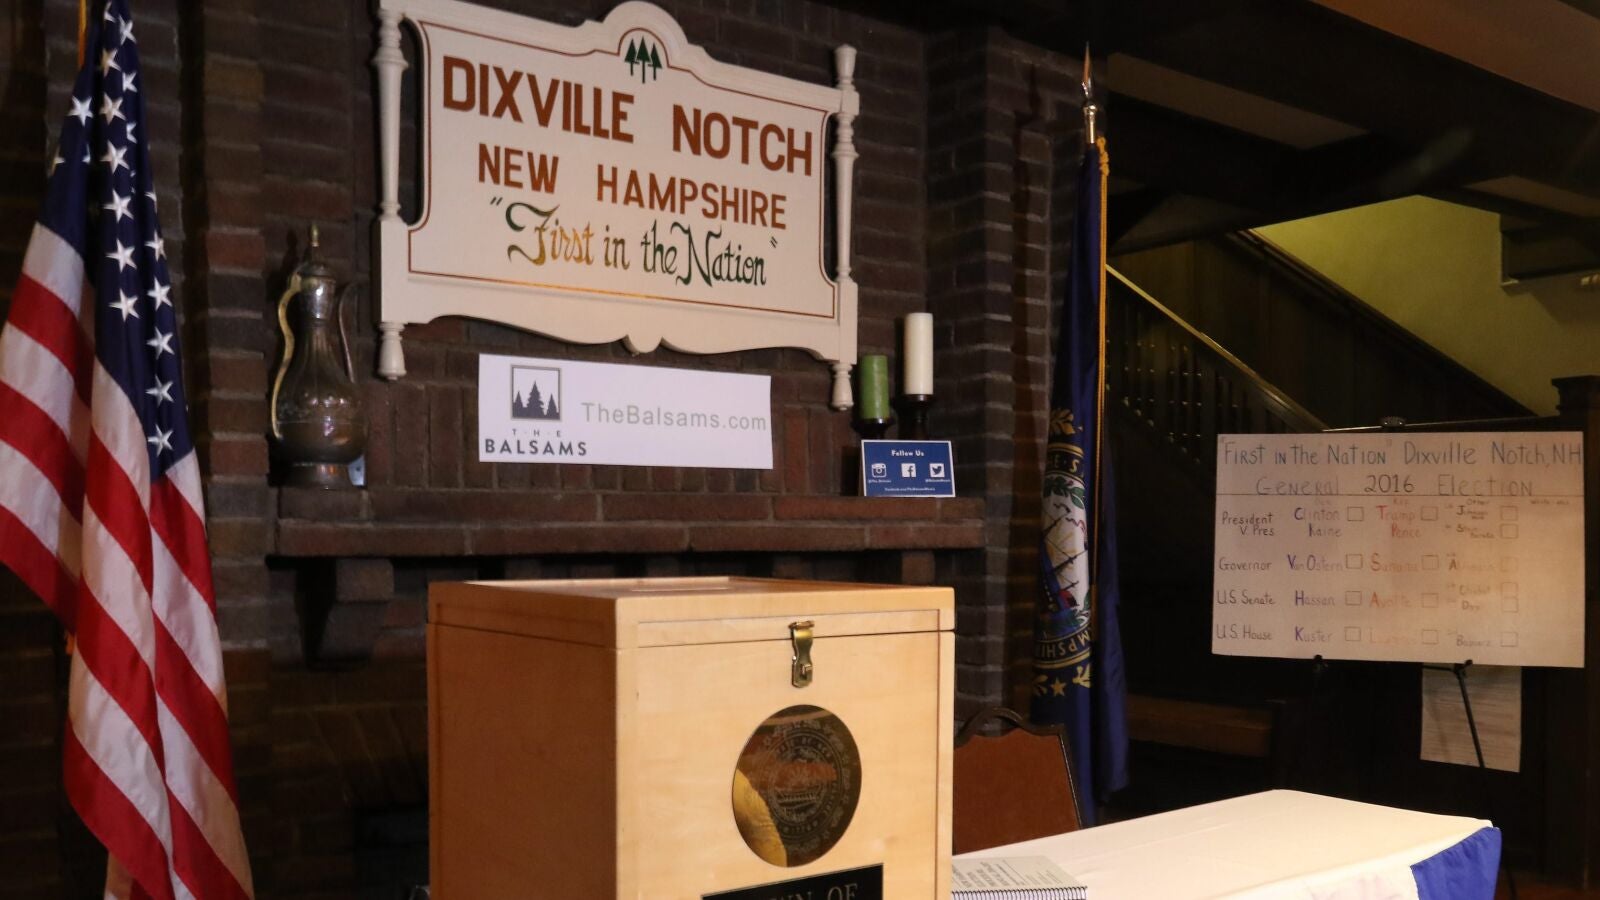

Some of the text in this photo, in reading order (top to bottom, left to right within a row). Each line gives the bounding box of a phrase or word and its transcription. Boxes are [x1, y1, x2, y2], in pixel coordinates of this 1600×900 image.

[442, 55, 813, 177] DIXVILLE NOTCH
[478, 143, 787, 230] NEW HAMPSHIRE
[603, 226, 630, 271] in
[641, 219, 677, 274] the
[581, 402, 768, 431] TheBalsams.com
[484, 438, 588, 456] BALSAMS
[890, 449, 925, 457] Follow Us
[1404, 441, 1477, 465] Dixville
[1364, 474, 1415, 493] 2016
[1222, 504, 1416, 525] President Clinton Trump
[1253, 525, 1275, 537] Pres
[1219, 556, 1273, 571] Governor
[1241, 589, 1276, 605] Senate
[1295, 590, 1336, 606] Hassan
[1243, 623, 1273, 641] House
[1295, 626, 1334, 642] Kuster
[827, 882, 858, 900] OF
